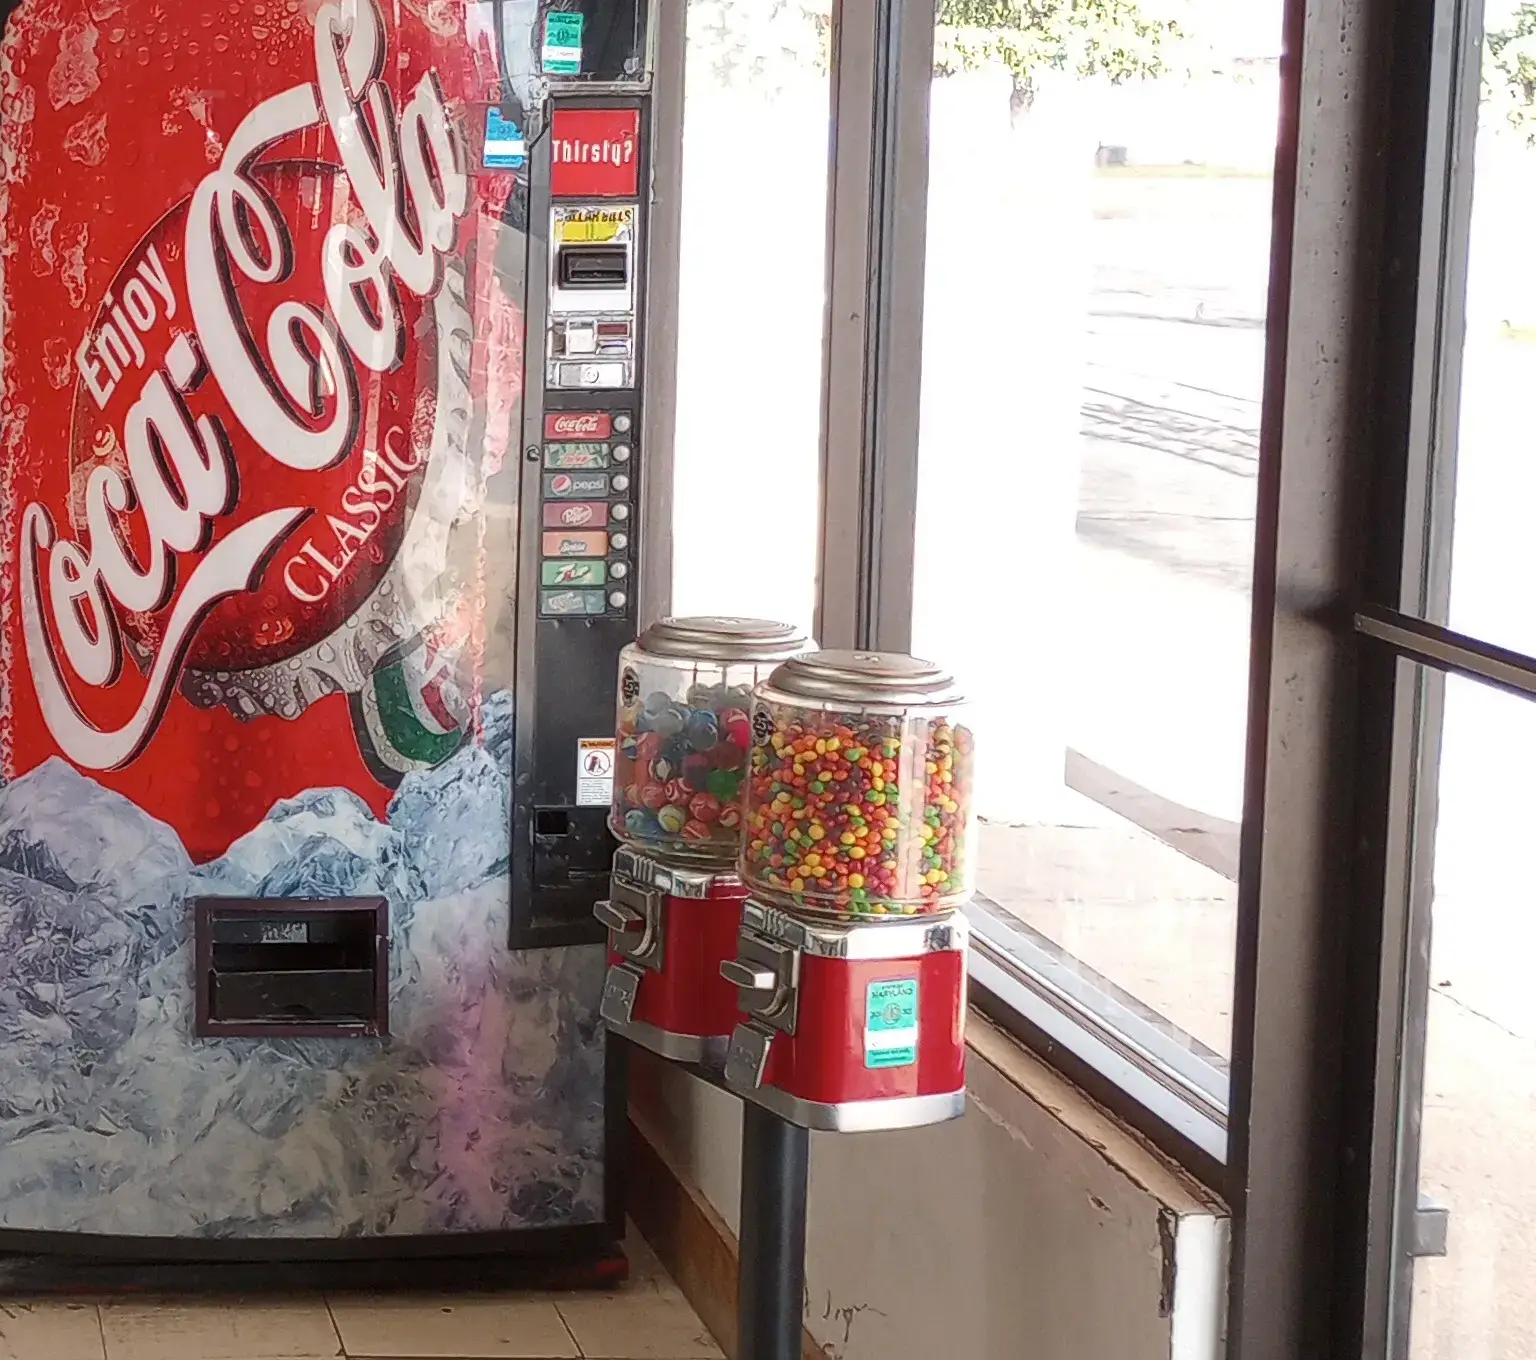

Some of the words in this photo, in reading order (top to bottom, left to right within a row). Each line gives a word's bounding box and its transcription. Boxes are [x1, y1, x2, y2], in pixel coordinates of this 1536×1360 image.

[551, 139, 634, 168] Thirsty?
[73, 243, 181, 412] Enjoy
[554, 415, 599, 433] Coca-Cola
[572, 478, 605, 491] pepsi
[284, 423, 426, 606] CLASSIC
